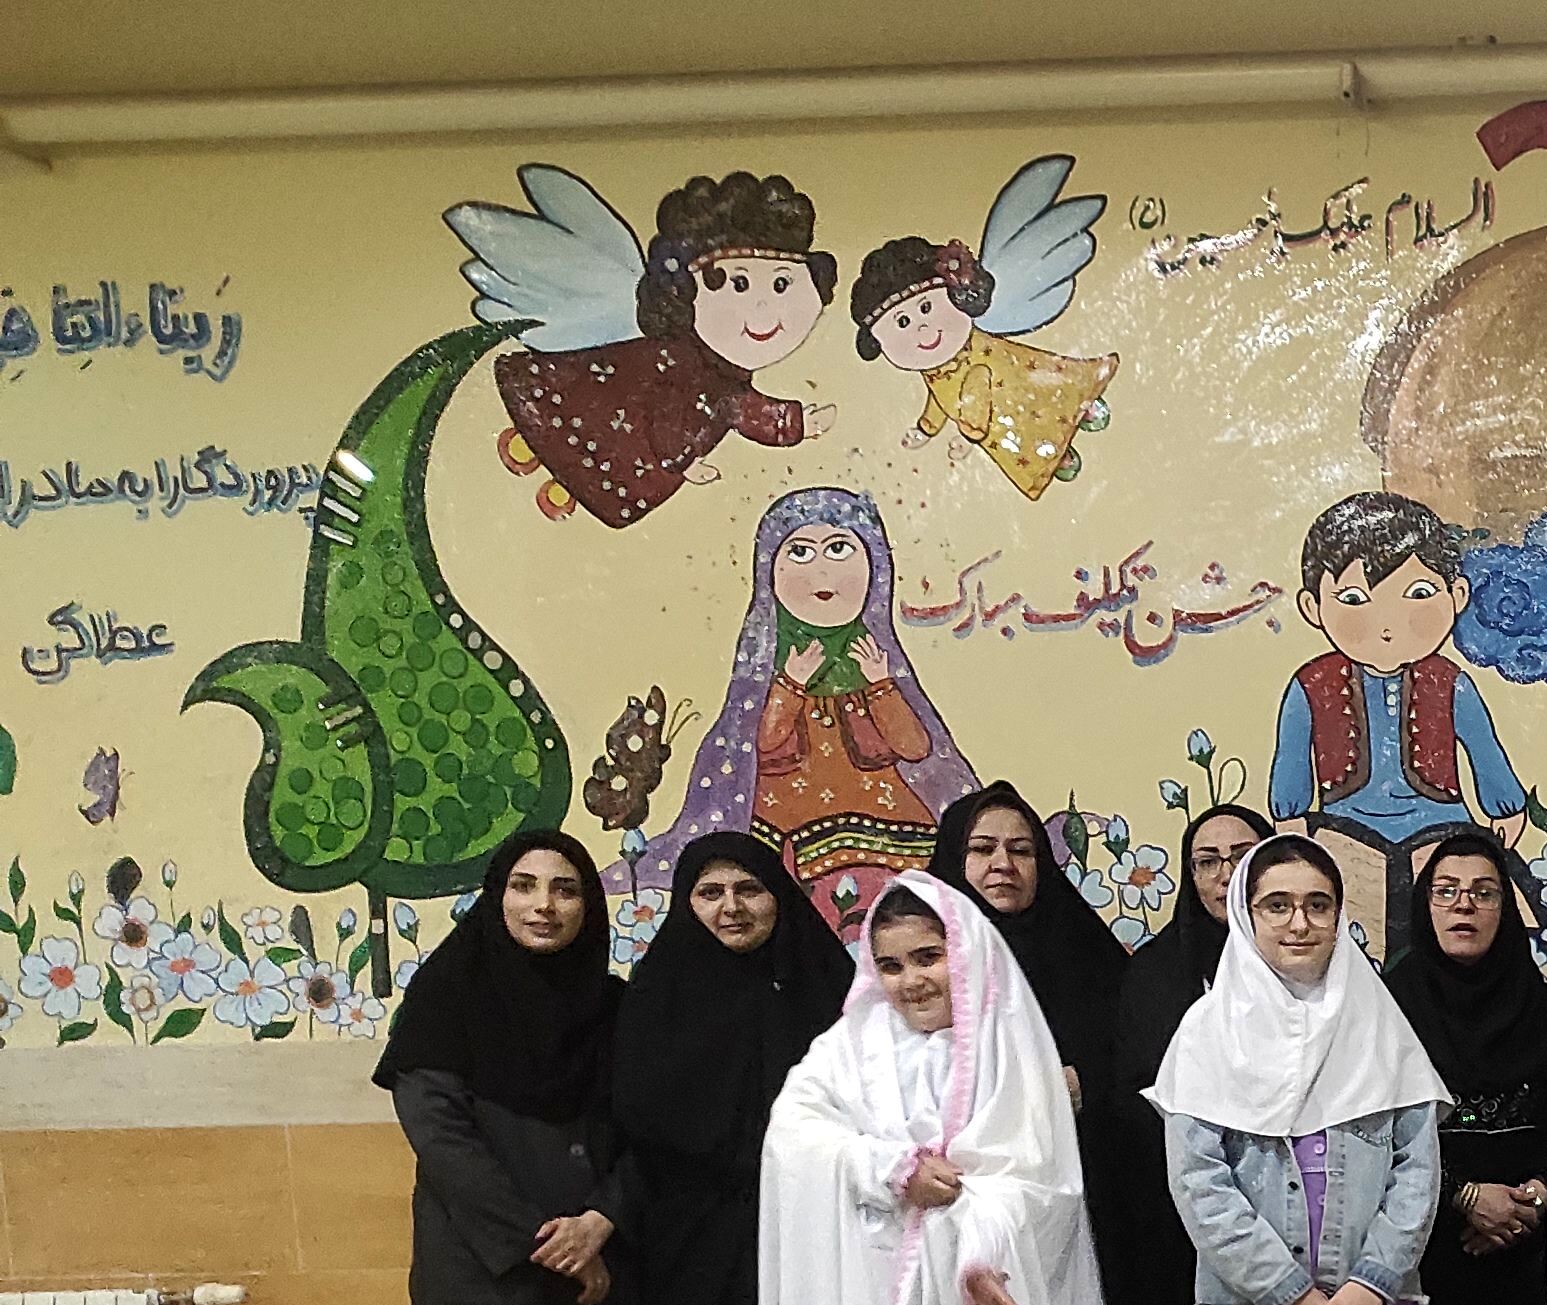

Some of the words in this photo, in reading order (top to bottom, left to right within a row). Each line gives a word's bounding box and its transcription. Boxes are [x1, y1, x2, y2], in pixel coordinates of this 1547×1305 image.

[1385, 176, 1497, 264] السلام
[899, 549, 1025, 641] مبارک
[1022, 540, 1158, 640] تکلیف
[1122, 560, 1287, 668] جشن
[20, 599, 96, 685] کن
